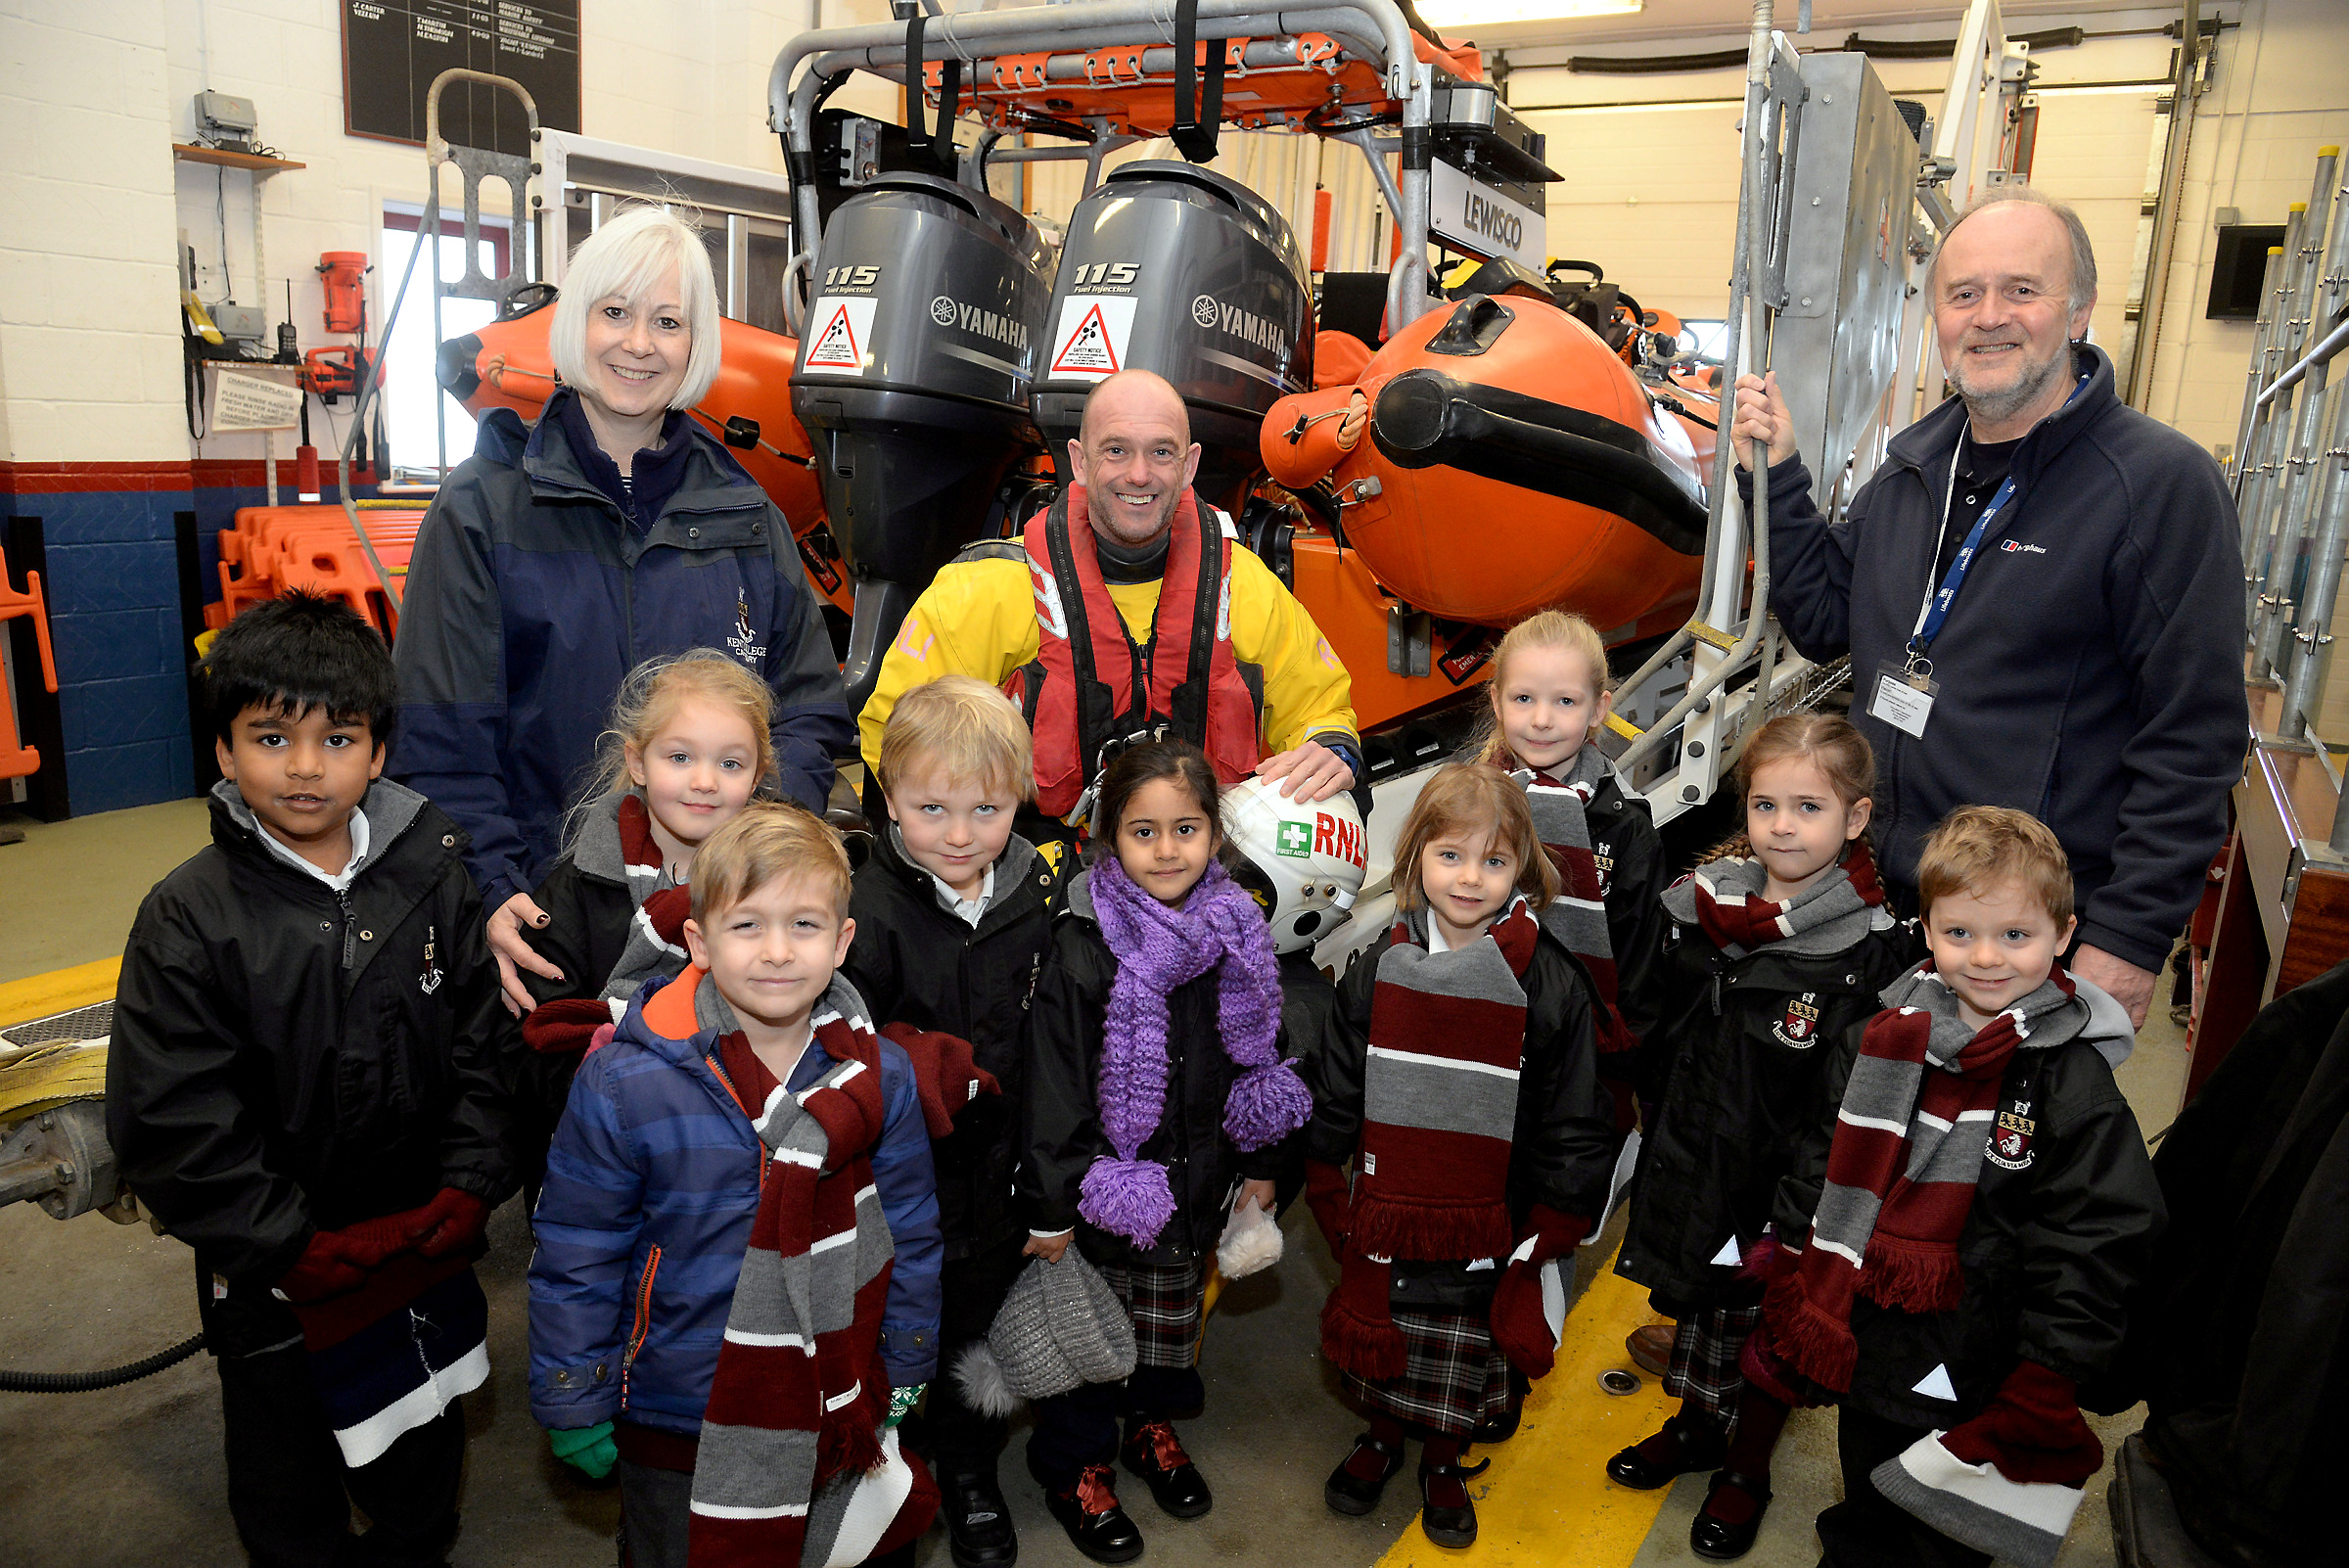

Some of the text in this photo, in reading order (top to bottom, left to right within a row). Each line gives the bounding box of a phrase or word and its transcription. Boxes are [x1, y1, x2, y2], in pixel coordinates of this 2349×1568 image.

[1464, 191, 1522, 252] LEWISCO
[825, 265, 881, 287] 115
[1074, 262, 1141, 285] 115
[839, 286, 872, 295] Injection
[959, 301, 1028, 352] YAMAHA
[1221, 301, 1285, 357] YAMAHA
[222, 390, 246, 400] PLEASE
[243, 401, 266, 411] WATER
[1959, 548, 1974, 572] Lifeboats
[1940, 589, 1955, 613] Lifeboats
